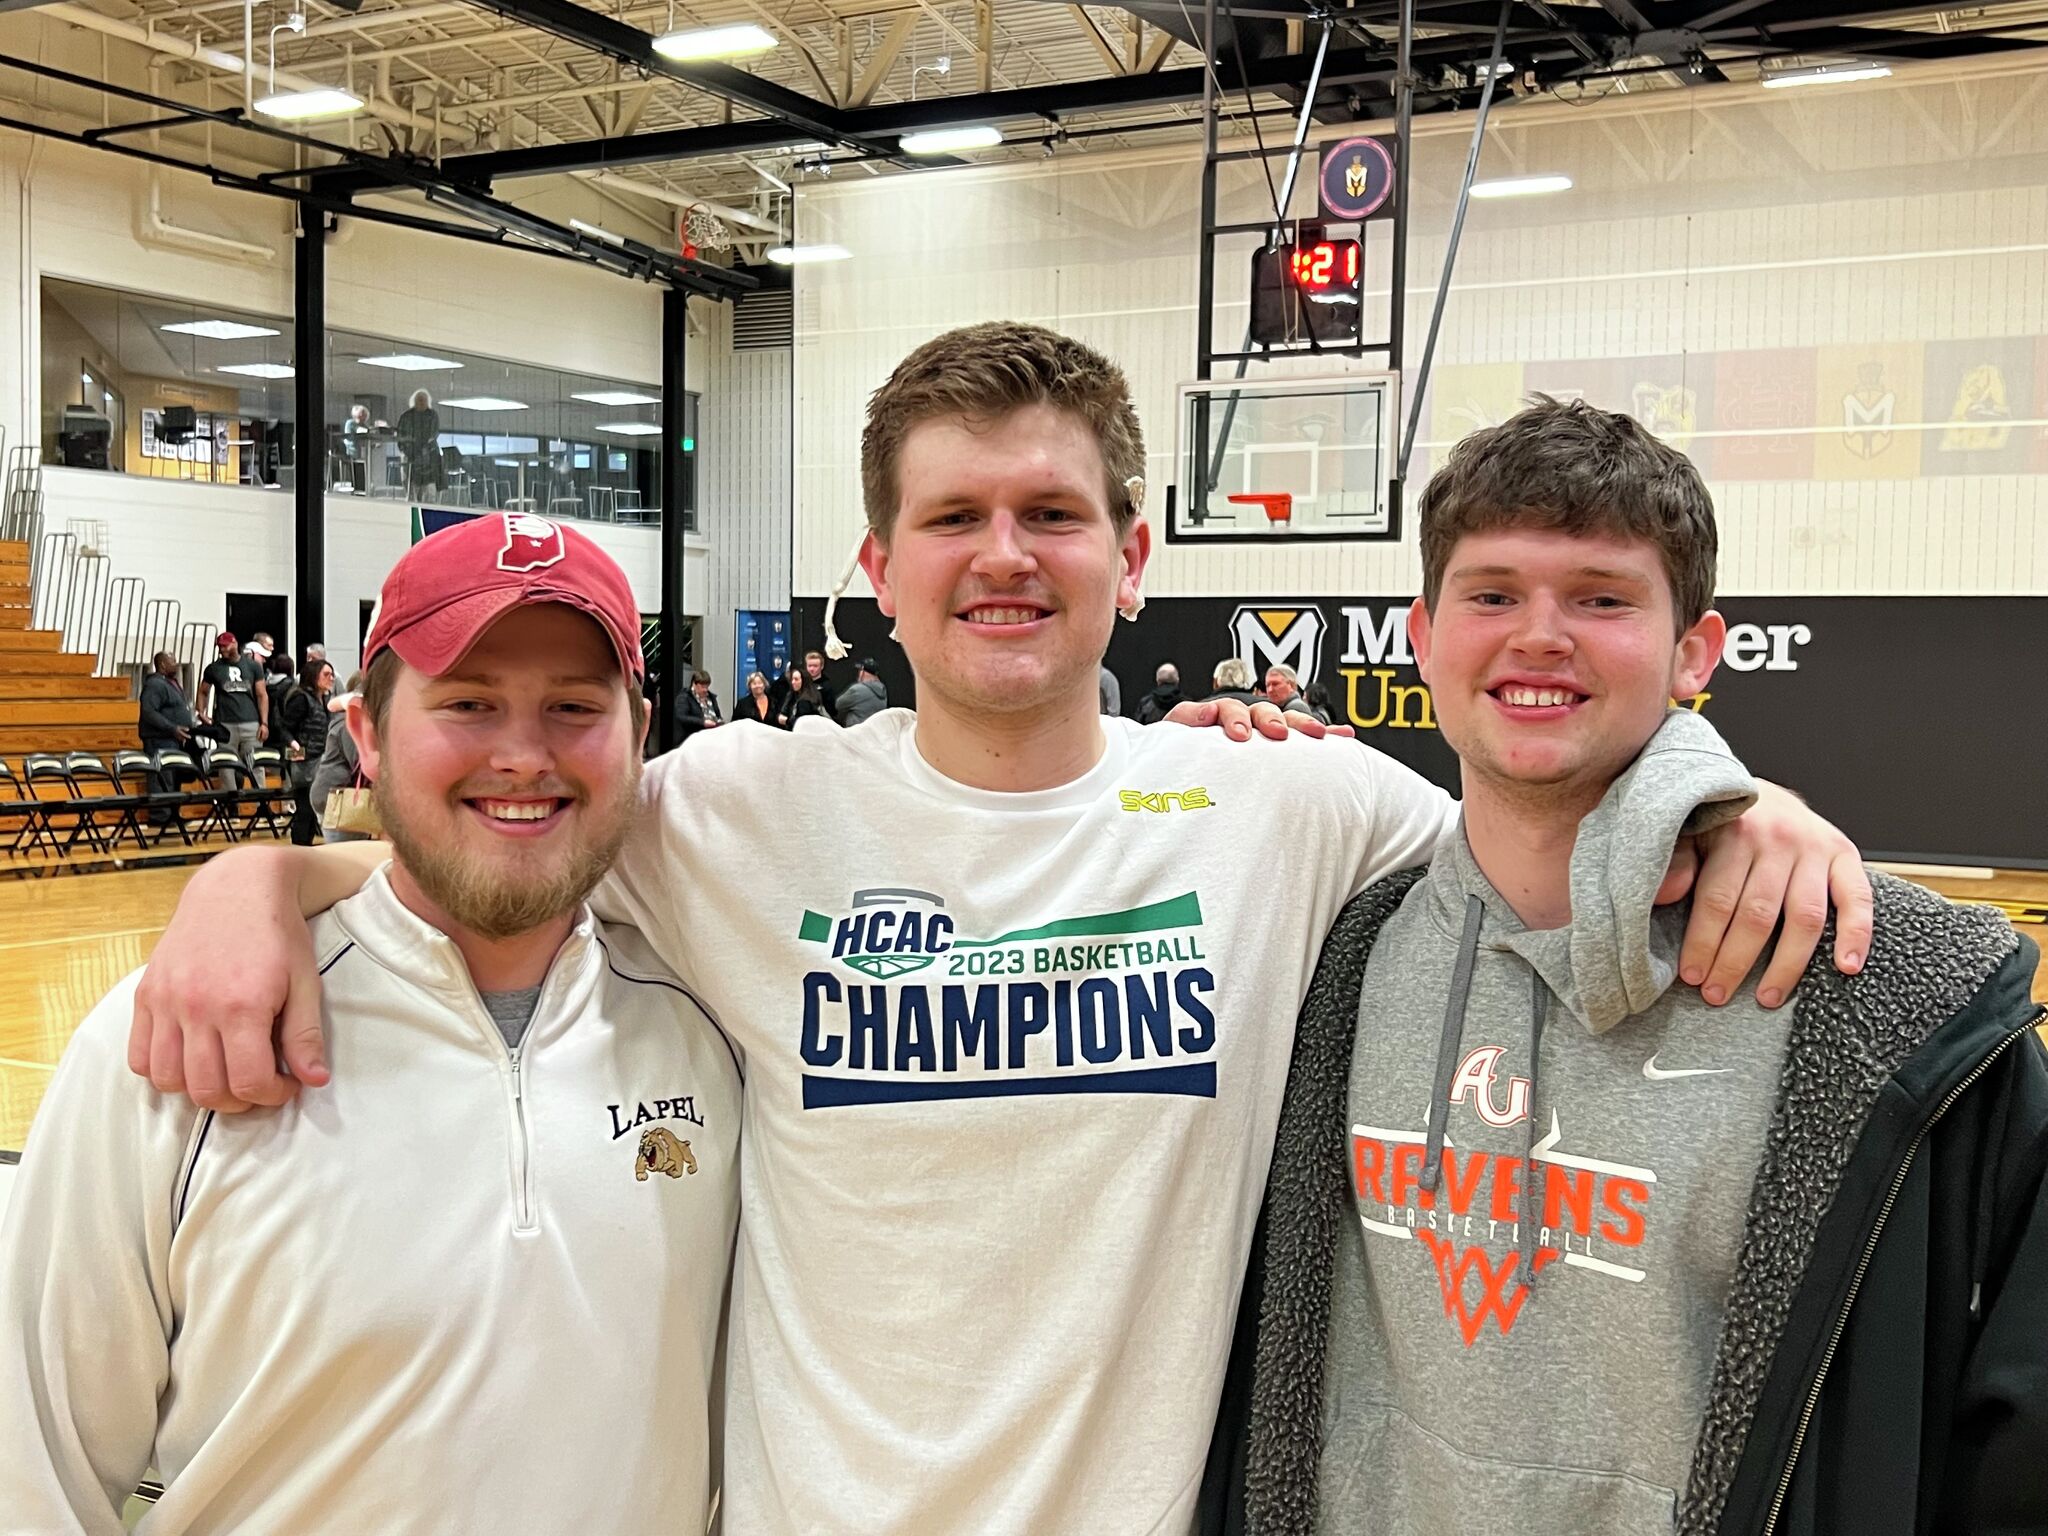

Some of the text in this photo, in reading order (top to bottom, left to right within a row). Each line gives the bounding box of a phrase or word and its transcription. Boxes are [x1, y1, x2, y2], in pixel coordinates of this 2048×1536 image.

[229, 666, 243, 682] R
[832, 911, 954, 959] HCAC
[948, 936, 1206, 977] 2023 BASKETBALL
[800, 967, 1216, 1073] CHAMPIONS
[1449, 1045, 1531, 1128] AU
[607, 1096, 705, 1141] LAPEL
[1353, 1135, 1649, 1247] RAVENS
